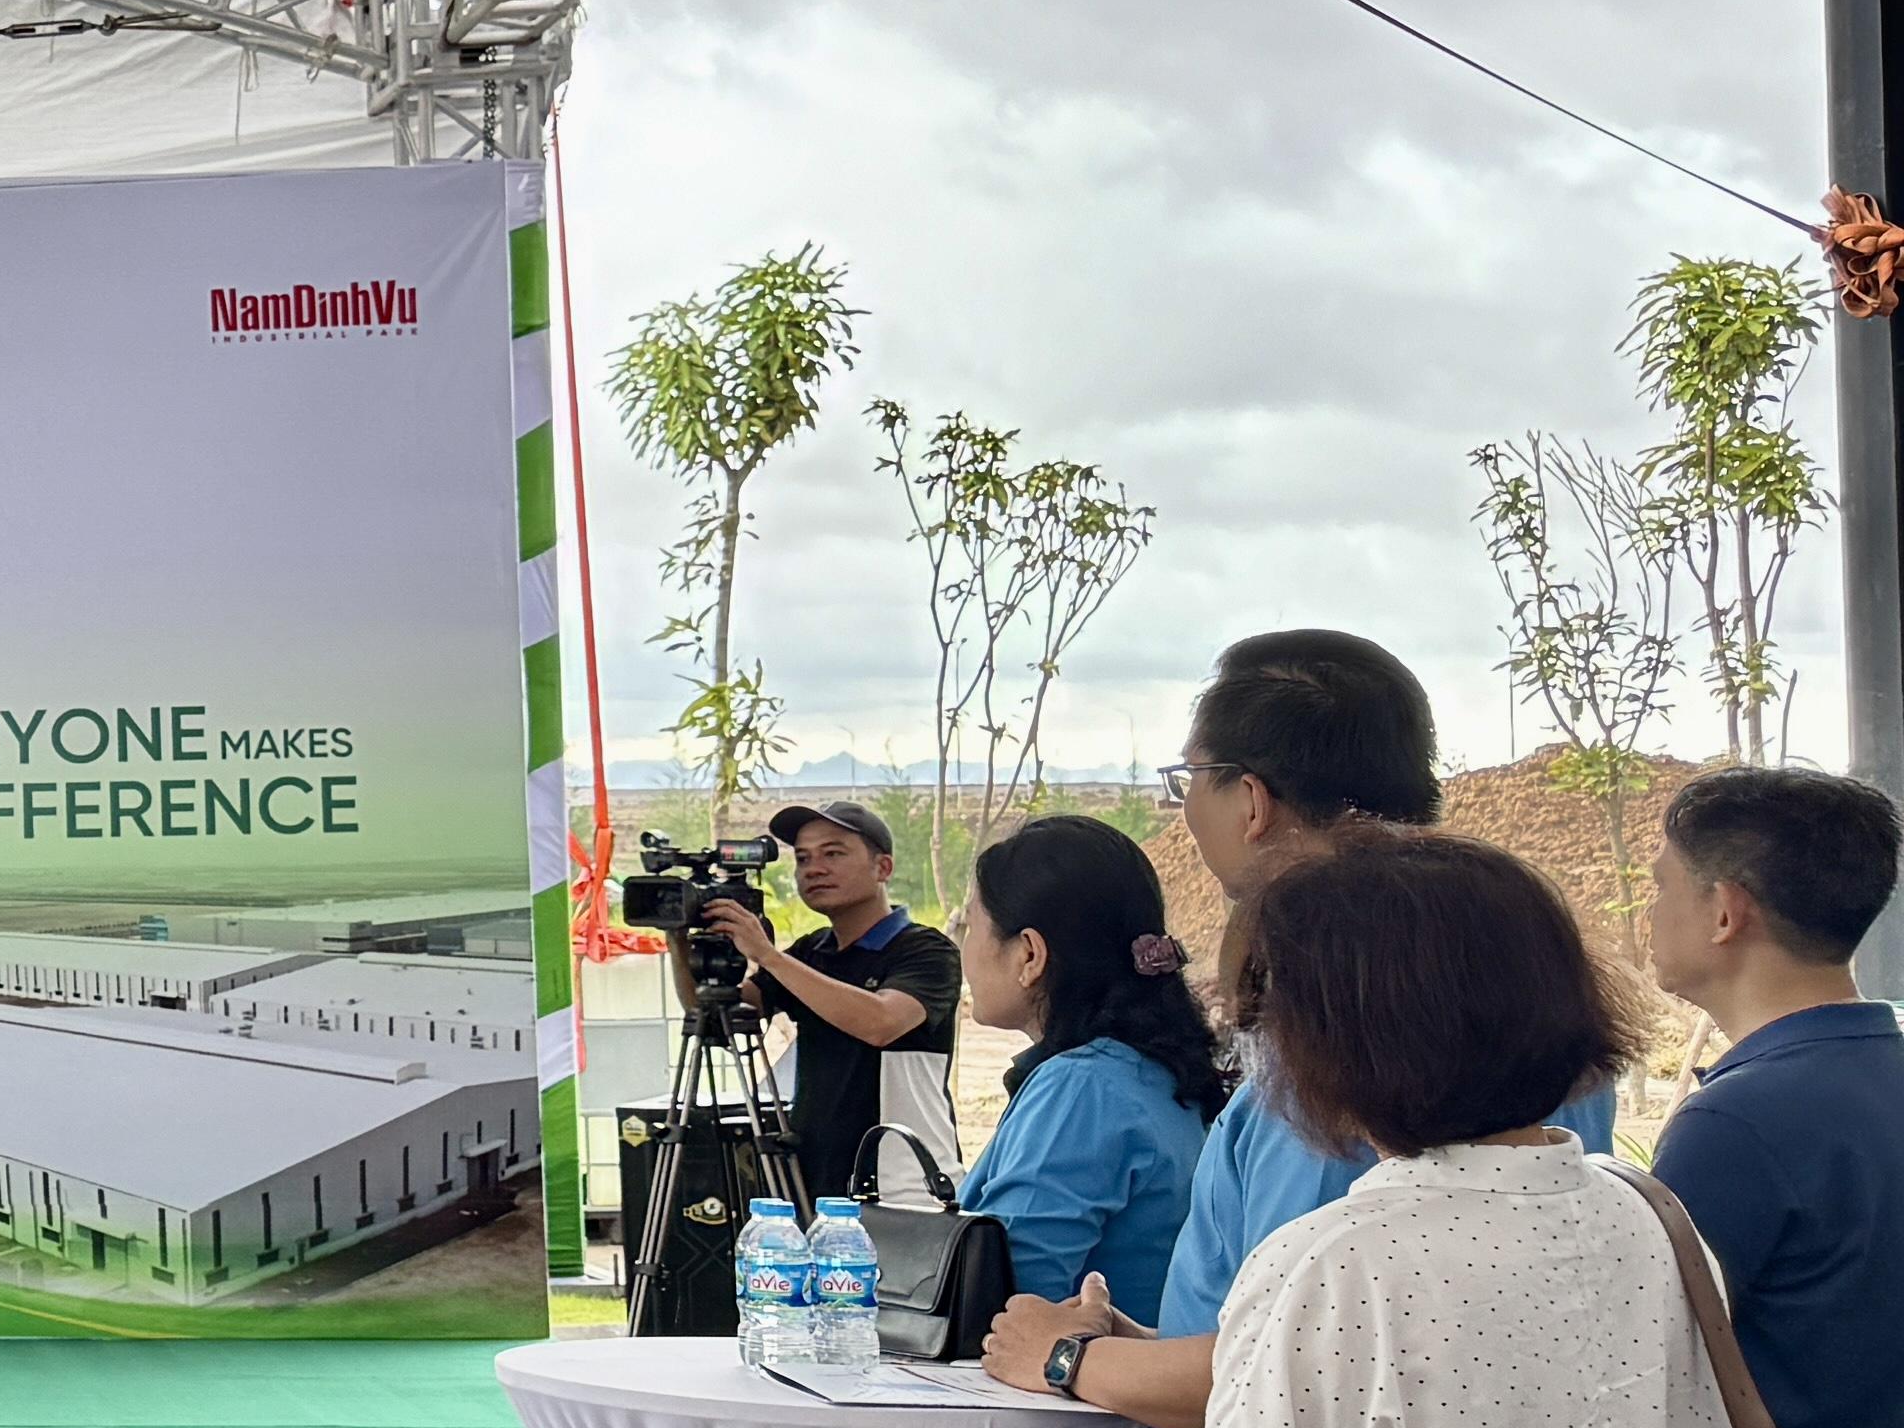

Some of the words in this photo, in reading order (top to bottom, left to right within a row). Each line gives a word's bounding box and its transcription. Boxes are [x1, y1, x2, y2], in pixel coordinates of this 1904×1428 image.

[210, 280, 418, 332] NamDinhVu
[211, 330, 347, 345] INDUSTRIAL
[366, 327, 419, 338] PARK
[219, 727, 354, 760] MAKES
